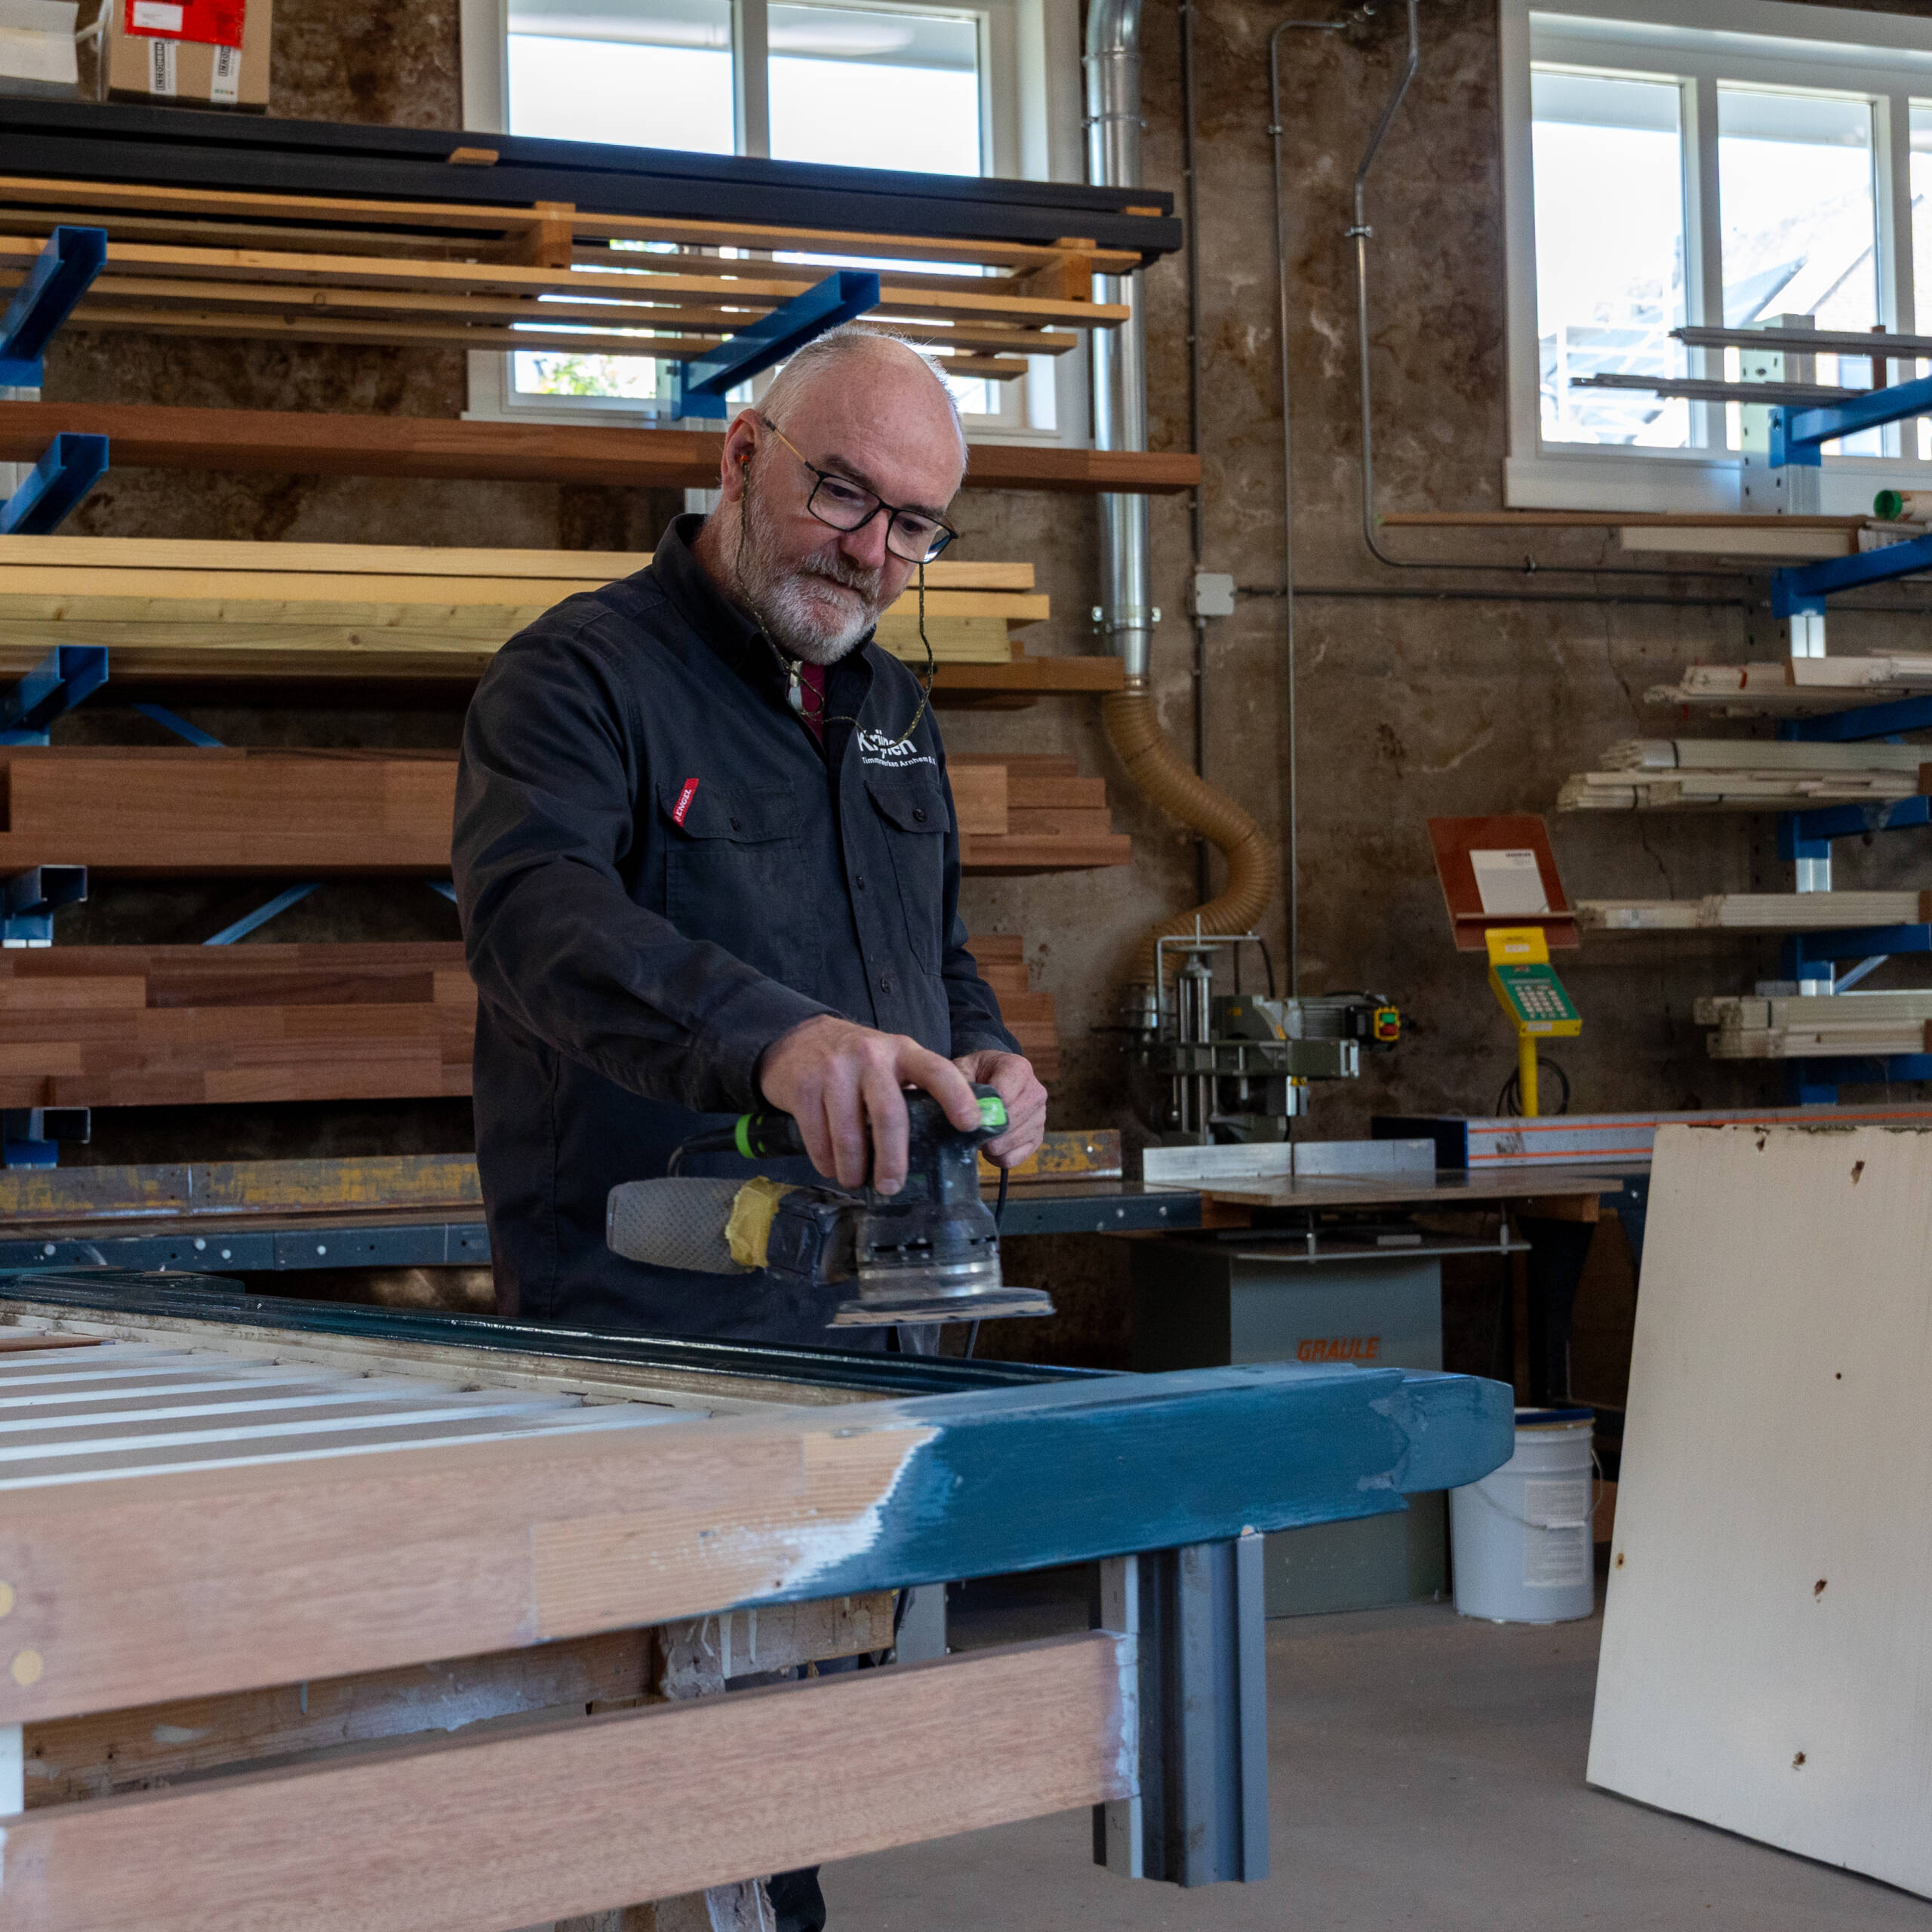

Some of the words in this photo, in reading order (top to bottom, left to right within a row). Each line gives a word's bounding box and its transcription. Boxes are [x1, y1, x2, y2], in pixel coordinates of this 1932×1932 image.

[900, 757, 928, 767] Arnhem
[675, 789, 692, 817] ENGEL
[1297, 1338, 1380, 1361] GRAULE
